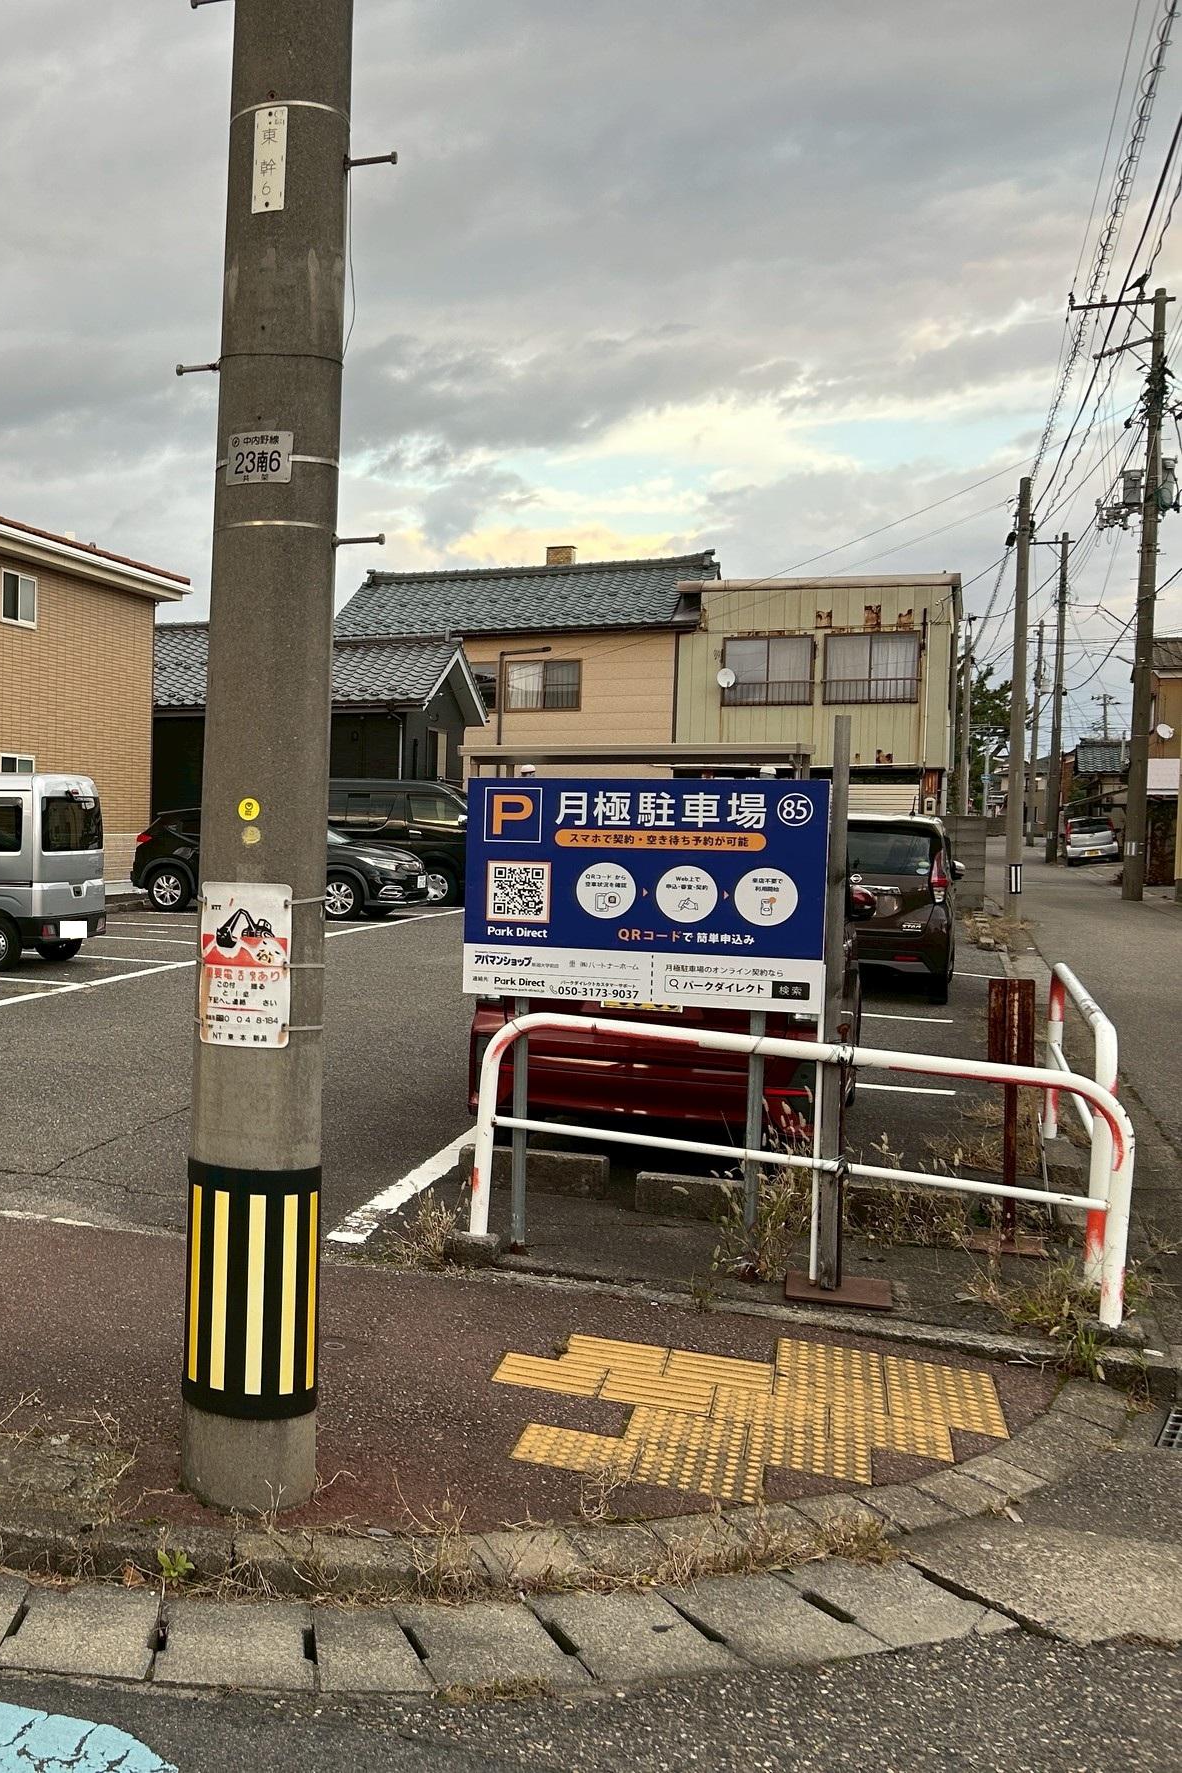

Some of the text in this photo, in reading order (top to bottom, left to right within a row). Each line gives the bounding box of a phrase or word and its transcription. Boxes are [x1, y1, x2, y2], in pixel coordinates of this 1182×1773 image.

[234, 450, 281, 474] 23南6
[492, 794, 534, 835] P
[554, 791, 767, 830] 月極駐車場
[781, 800, 808, 820] 85
[569, 833, 749, 848] スマホで契約・空き待ち予約が可能
[487, 926, 548, 938] Park Direct
[474, 954, 533, 967] アパマンショップ
[665, 964, 784, 977] 月極駐車場のオンライン契約なら
[494, 976, 545, 987] Park Direct
[560, 980, 636, 988] パークダイレクトカスタマーサポート
[683, 981, 764, 994] パークダイレクト
[558, 986, 640, 999] 050-3173-9037
[778, 985, 803, 996] 検索
